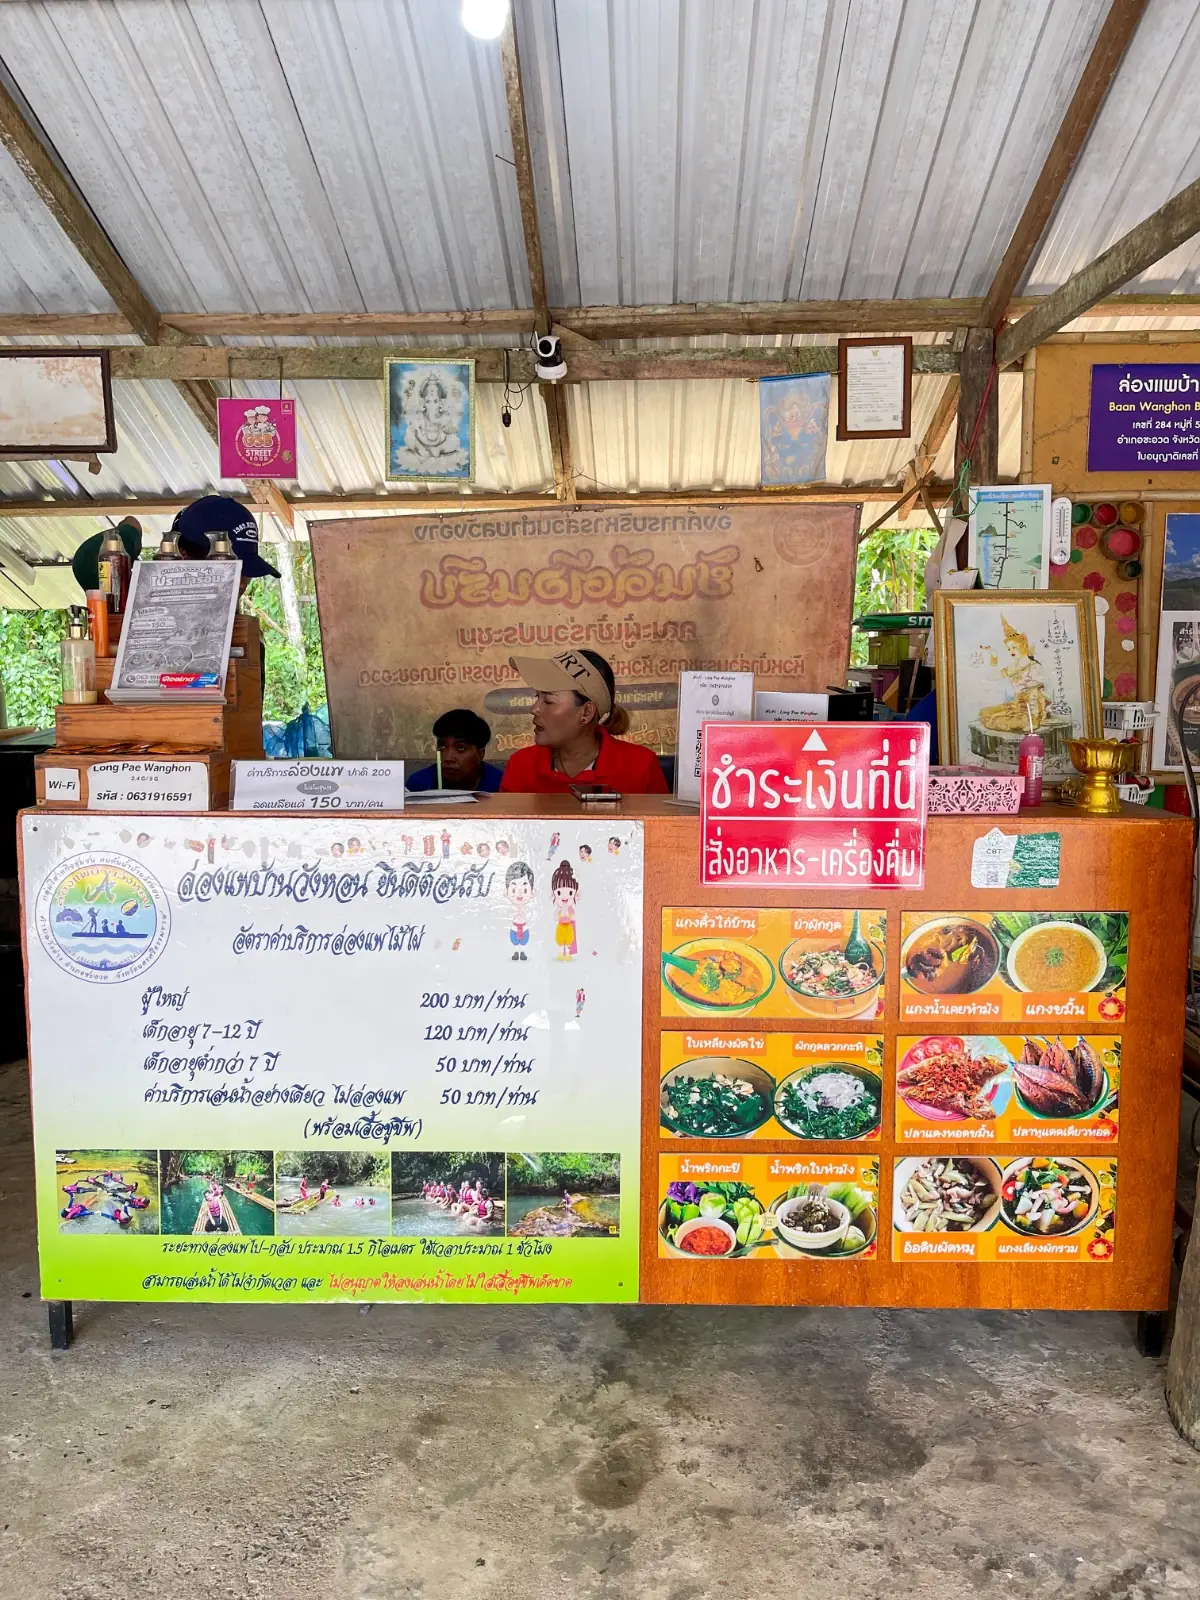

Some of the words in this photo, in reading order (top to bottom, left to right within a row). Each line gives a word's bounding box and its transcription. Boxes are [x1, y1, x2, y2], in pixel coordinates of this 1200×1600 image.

[1108, 402, 1136, 412] Baan
[1139, 401, 1191, 414] Wanghon
[1132, 417, 1153, 429] เลขที่
[1155, 421, 1171, 429] 284
[1174, 417, 1192, 431] หมู่ที่
[242, 433, 274, 447] GSB
[1117, 434, 1169, 444] อำเภอชะอวด
[93, 763, 119, 774] Long
[121, 763, 142, 772] Pae
[144, 763, 192, 774] Wanghon
[348, 767, 369, 777] ปกติ
[372, 769, 391, 777] 200
[711, 739, 916, 810] ชำระเงินที่นี่
[48, 780, 76, 790] Wi-Fi
[96, 790, 117, 801] รหัส
[126, 792, 193, 802] 0631916591
[252, 799, 306, 809] ลดเหลือแค่
[310, 797, 341, 809] 150
[345, 800, 384, 809] บาท/คน
[708, 826, 915, 877] สั่งอาหาร-เครื่องดื่ม
[178, 856, 373, 903] ล่องแพบ้านวังหอน
[374, 856, 496, 903] ยินดีต้อนรับ
[793, 918, 842, 933] ยำผักกูด
[232, 922, 425, 955] อัตราค่าบริการล่องแพไม้ไผ่
[140, 985, 190, 1016] ผู้ใหญ่
[419, 992, 450, 1008] 200
[452, 988, 529, 1012] บาท/ท่าน
[1025, 997, 1086, 1015] แกงขมิ้น
[142, 1018, 200, 1049] เด็กอายุ
[245, 1019, 263, 1040] ปี
[424, 1025, 453, 1041] 120
[456, 1020, 532, 1044] บาท/ท่าน
[143, 1045, 244, 1081] เด็กอายุต่ำกว่า
[250, 1055, 259, 1072] 7
[263, 1051, 282, 1072] ปี
[435, 1056, 457, 1073] 50
[460, 1053, 536, 1076] บาท/ท่าน
[144, 1077, 326, 1107] ค่าบริการเล่นน้ำอย่างเดียว
[332, 1083, 408, 1107] ไม่ล่องแพ
[440, 1088, 461, 1105] 50
[464, 1085, 540, 1108] บาท/ท่าน
[304, 1109, 422, 1145] (พร้อมเสื้อชูชีพ)
[680, 1159, 740, 1173] น้ำพริกกะปิ
[298, 1241, 343, 1256] ประมาณ
[346, 1242, 364, 1255] 1.5
[367, 1239, 416, 1258] กิโลเมตร
[506, 1242, 513, 1255] 1
[516, 1236, 553, 1258] ชั่วโมง
[301, 1276, 323, 1290] และ
